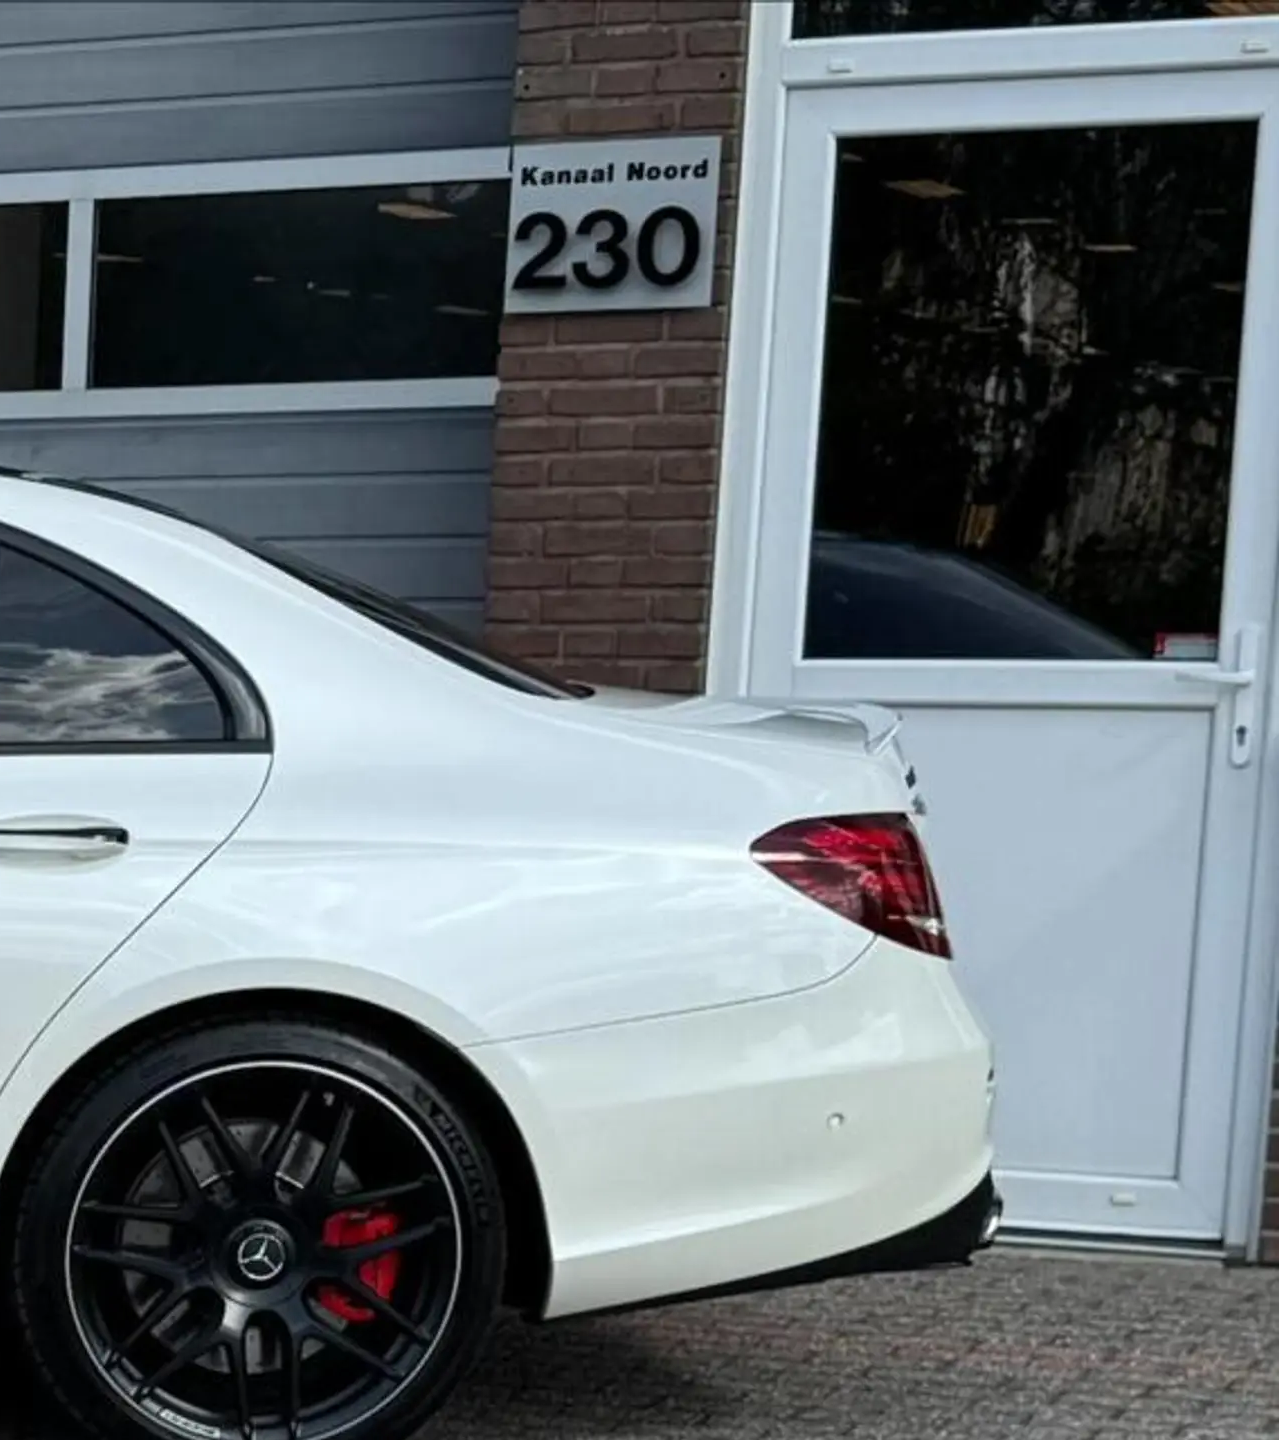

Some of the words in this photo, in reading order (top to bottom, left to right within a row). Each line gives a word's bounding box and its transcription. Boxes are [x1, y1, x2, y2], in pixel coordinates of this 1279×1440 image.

[520, 162, 615, 187] Kanaal
[627, 158, 709, 181] Noord
[511, 205, 700, 289] 230
